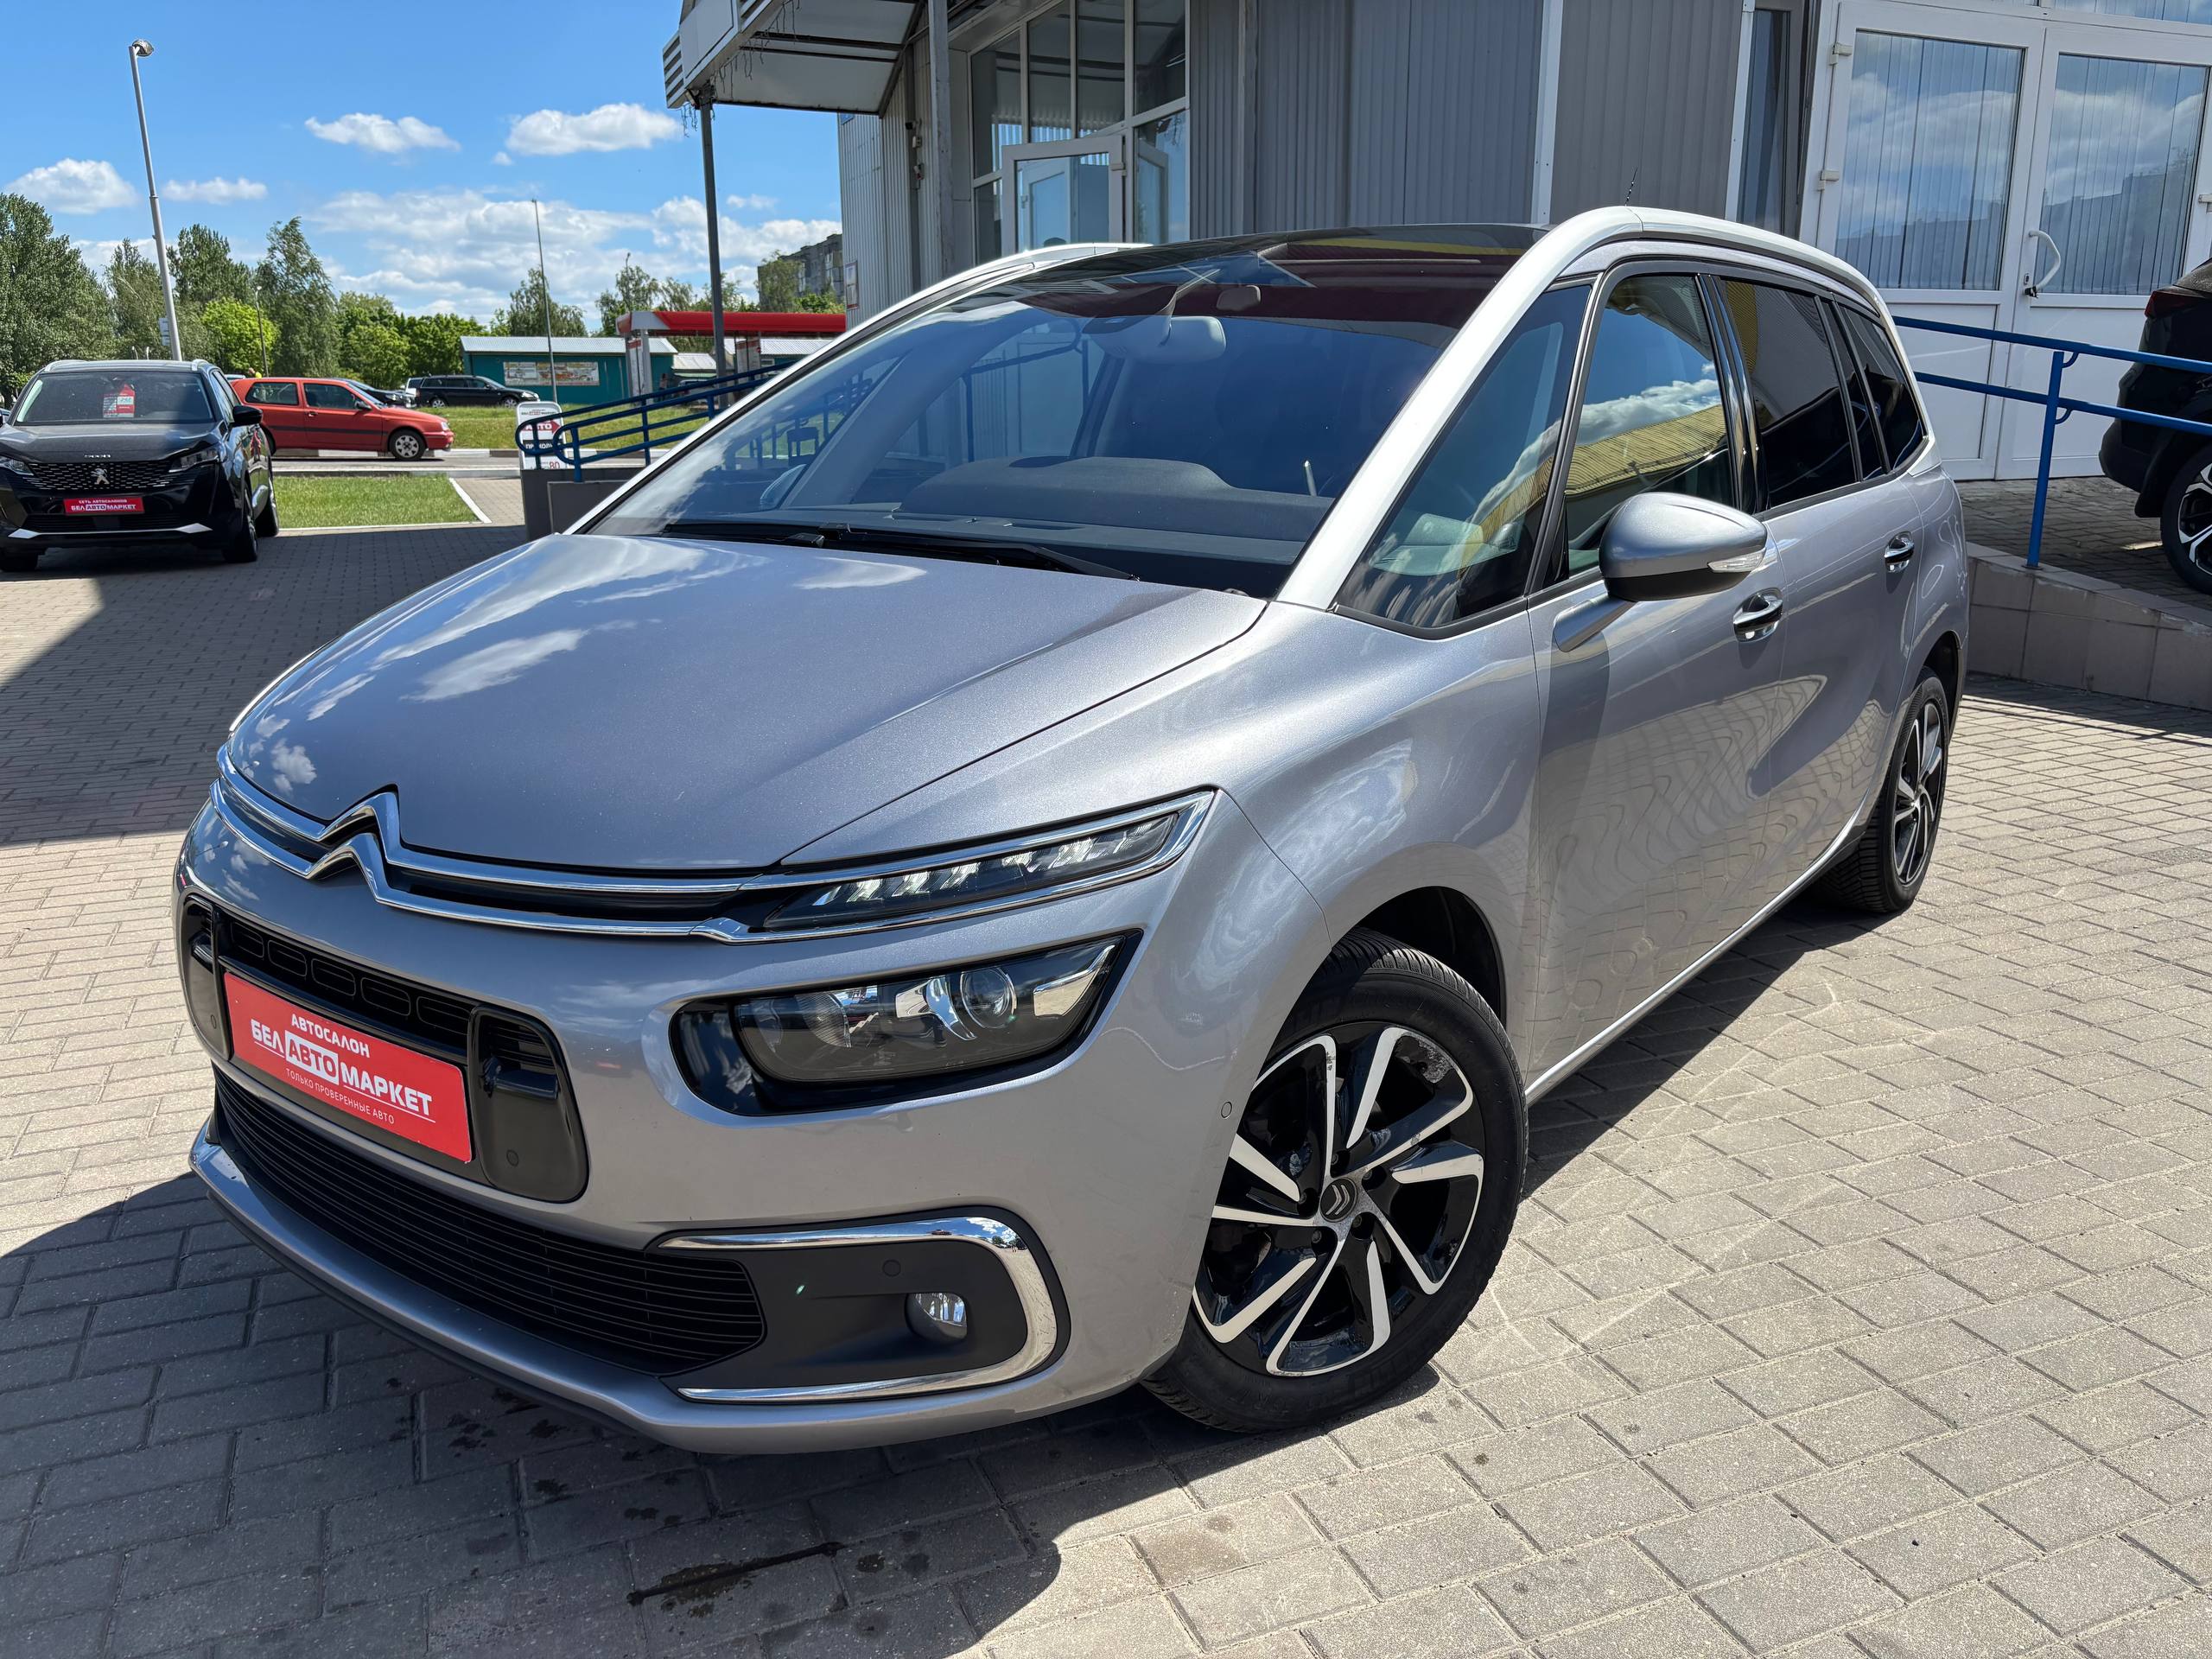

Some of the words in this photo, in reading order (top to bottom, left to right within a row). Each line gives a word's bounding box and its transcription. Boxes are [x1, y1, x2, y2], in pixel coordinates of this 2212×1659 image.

[291, 1014, 370, 1058] АВТОСАЛОН
[286, 1068, 314, 1089] ТОЛЬКО
[315, 1082, 371, 1115] ПРОВЕРЕННЫЕ
[372, 1109, 395, 1124] АВТО
